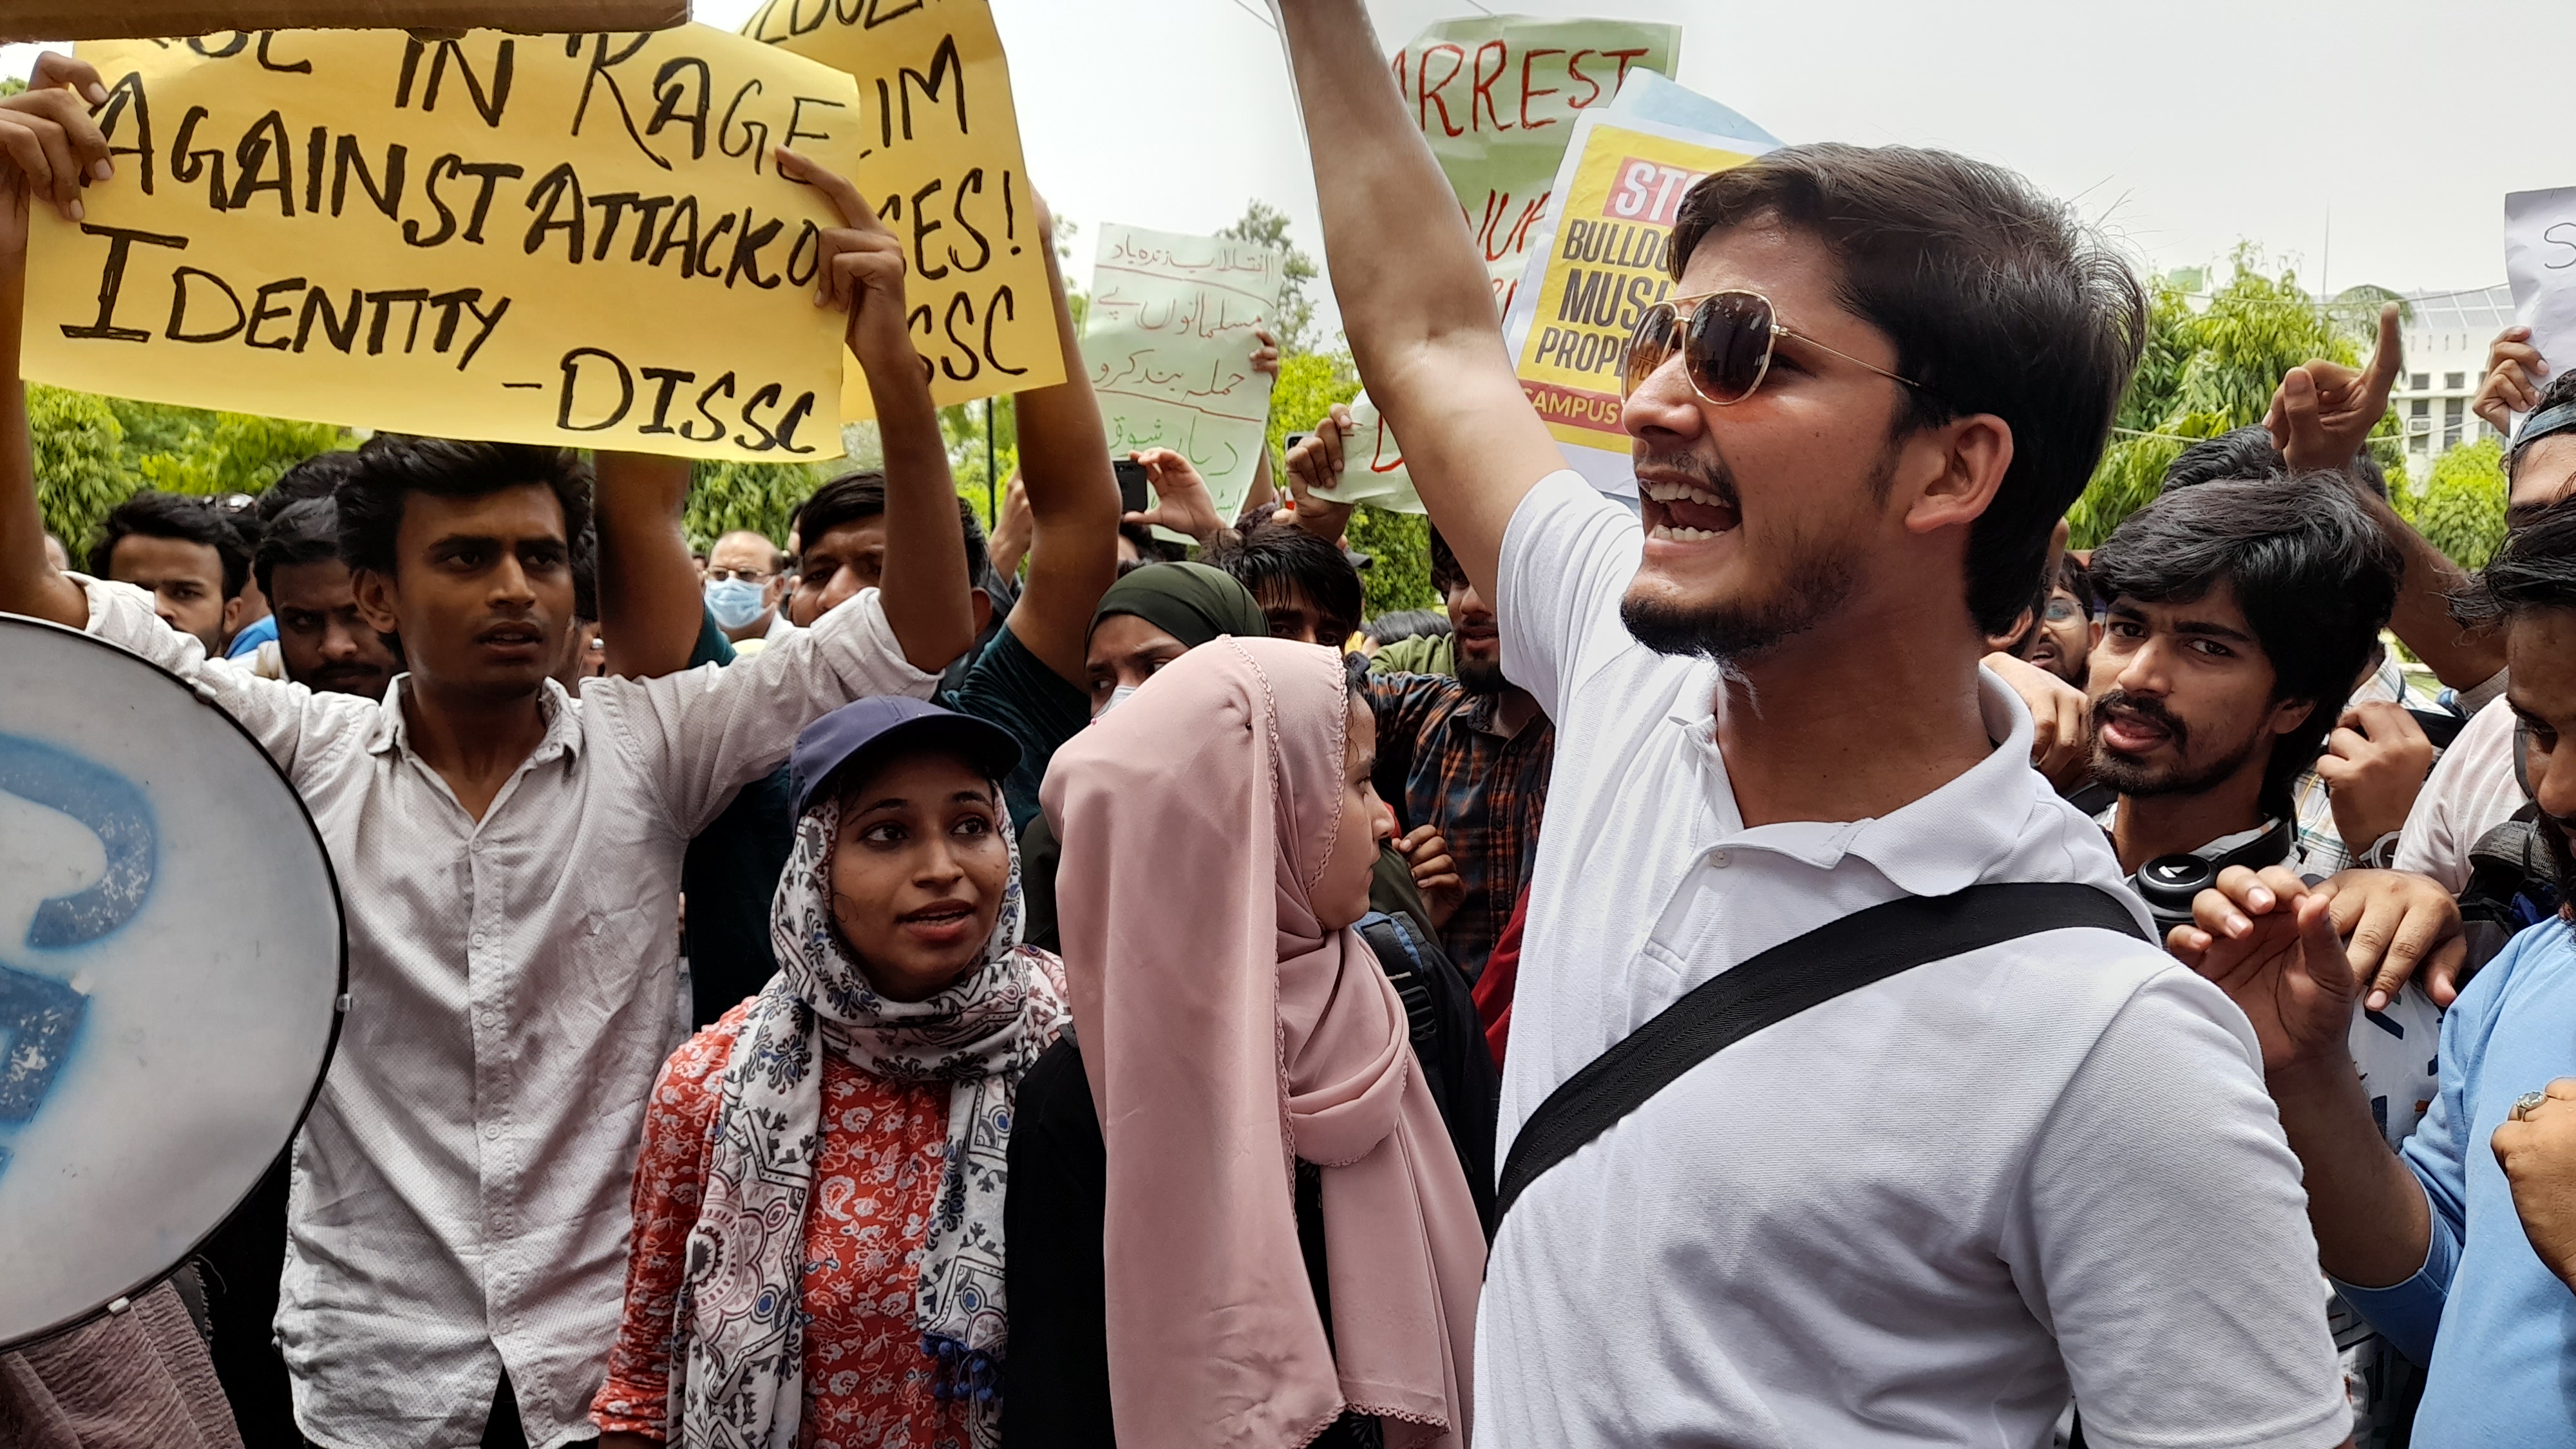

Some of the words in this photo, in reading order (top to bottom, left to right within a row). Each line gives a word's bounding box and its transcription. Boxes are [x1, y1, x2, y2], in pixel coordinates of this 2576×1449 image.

[82, 71, 524, 247] AGAINST
[859, 33, 968, 159] IM
[1615, 161, 1709, 222] ST
